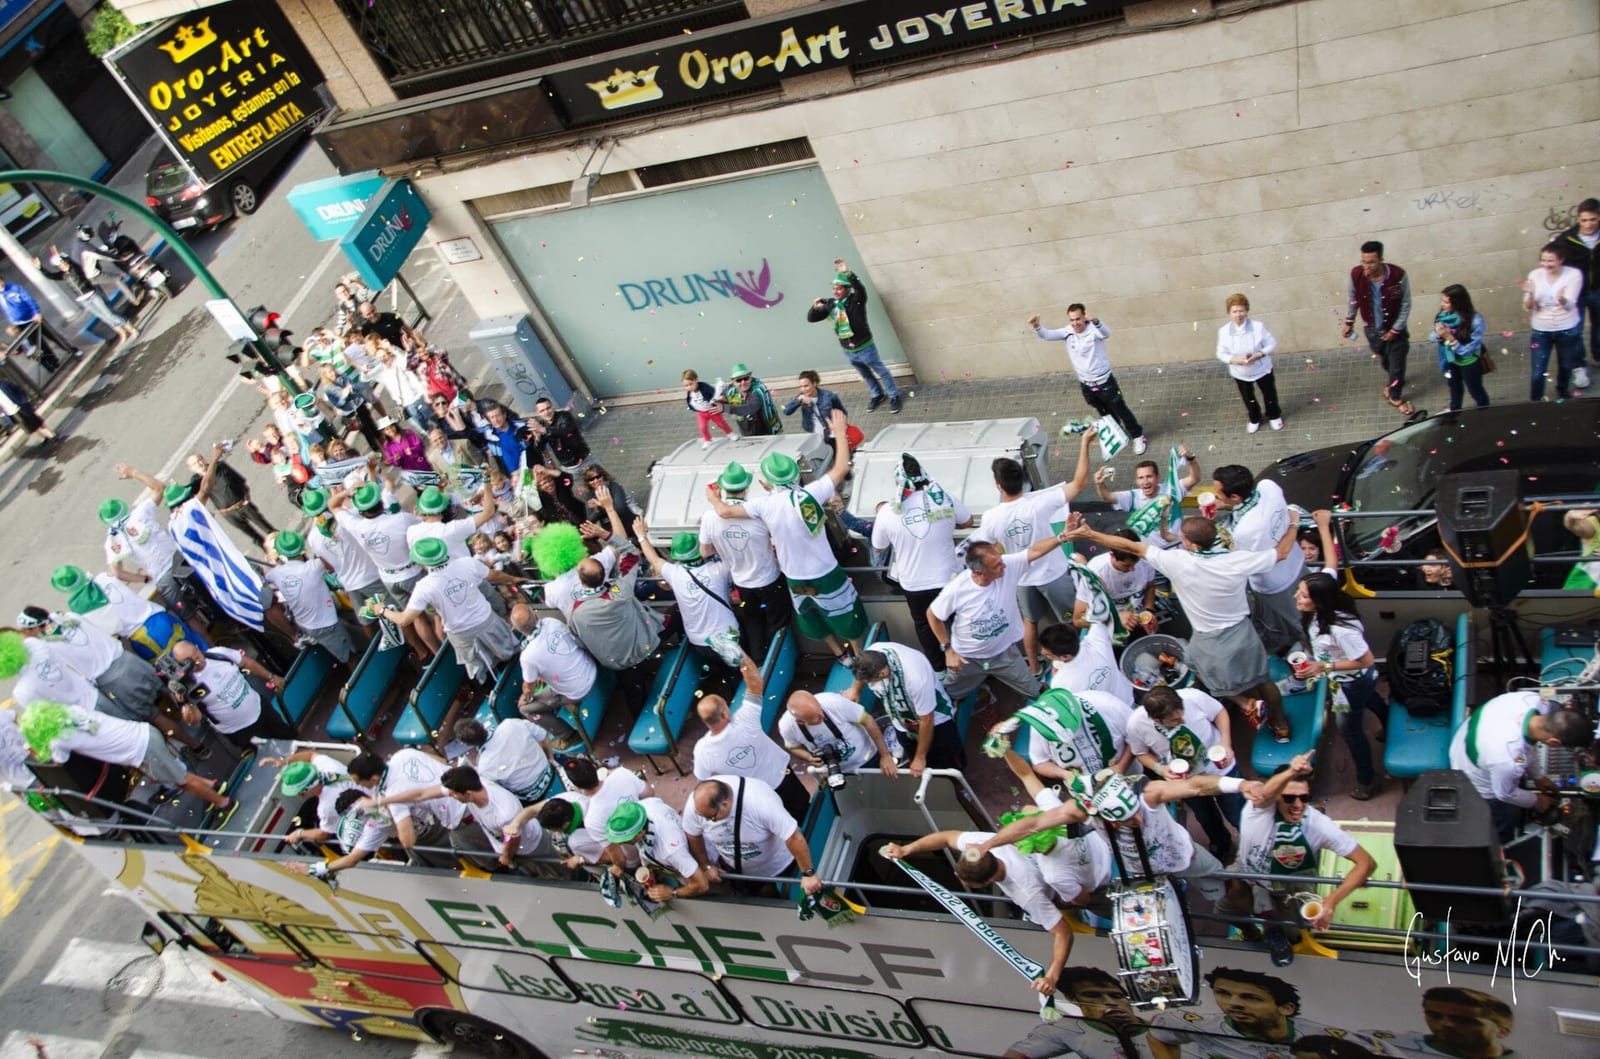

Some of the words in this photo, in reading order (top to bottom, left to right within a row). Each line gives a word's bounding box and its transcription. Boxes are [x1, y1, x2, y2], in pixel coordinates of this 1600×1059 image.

[149, 26, 269, 111] Oro-Art
[678, 24, 851, 91] Oro-Art
[869, 0, 1087, 50] JOYERIA
[168, 52, 286, 132] JOYERIA
[231, 87, 276, 122] estamos
[272, 77, 290, 97] en
[284, 70, 301, 88] la
[208, 101, 305, 171] ENTREPLANTA
[368, 214, 404, 263] DRUNI
[618, 269, 740, 312] DRUNI
[728, 746, 753, 768] ECF
[426, 898, 800, 983] ELCHE
[775, 934, 945, 989] CF
[494, 963, 665, 1013] Ascenso
[752, 994, 953, 1050] División
